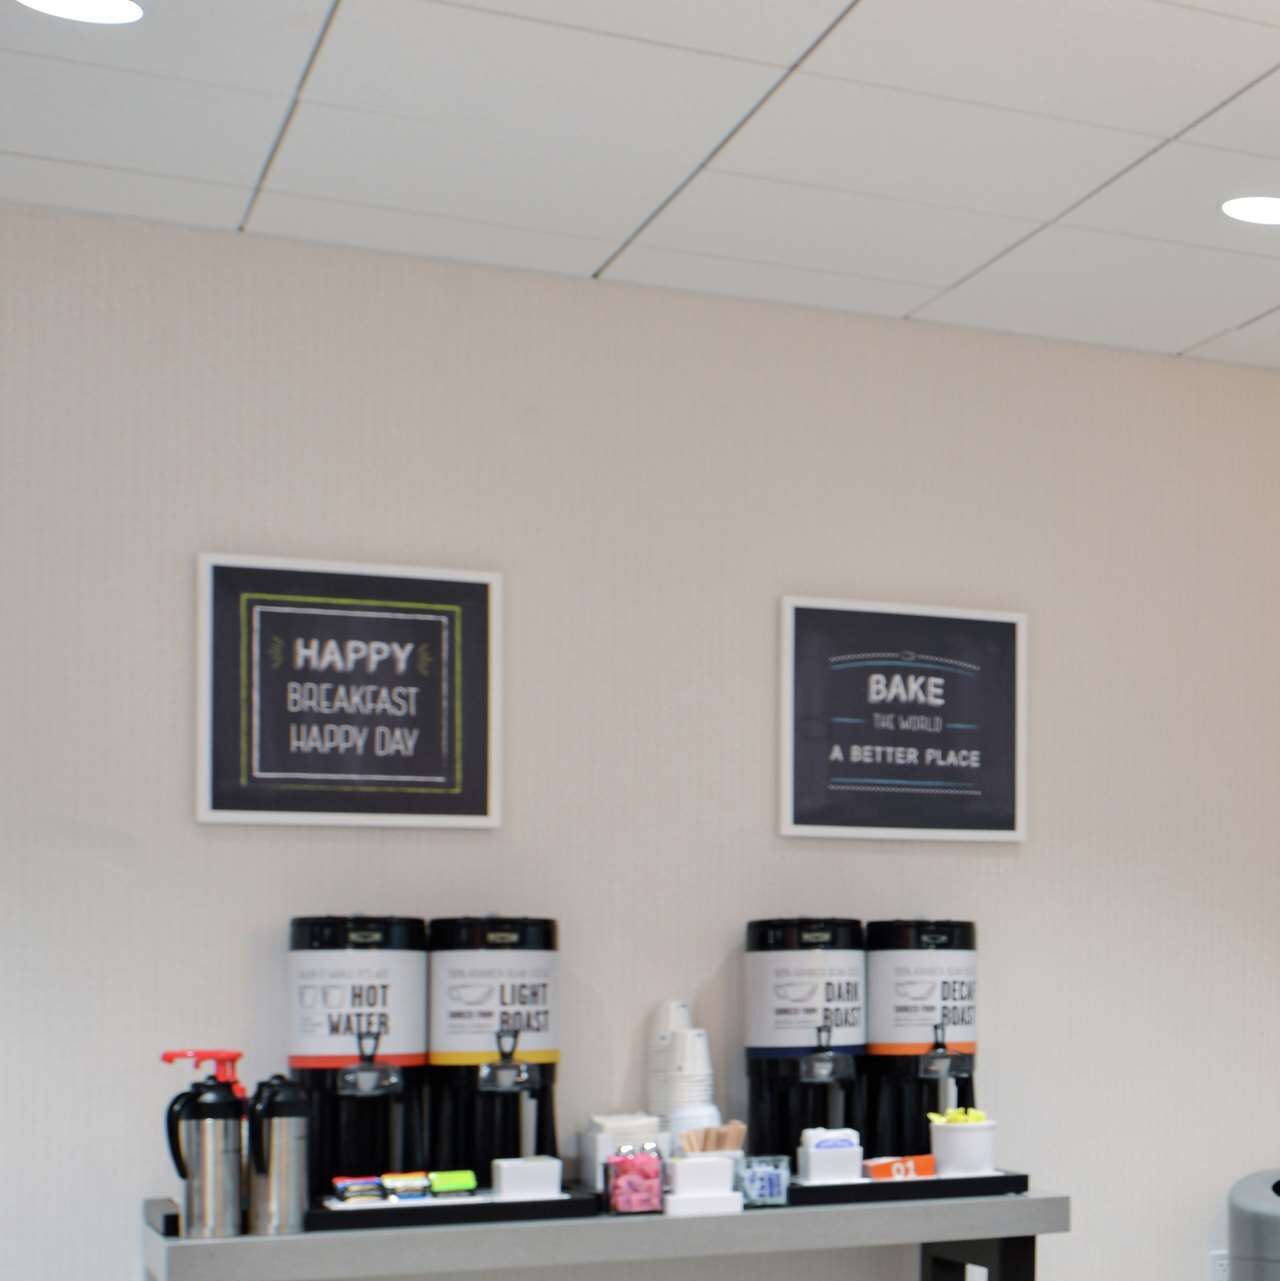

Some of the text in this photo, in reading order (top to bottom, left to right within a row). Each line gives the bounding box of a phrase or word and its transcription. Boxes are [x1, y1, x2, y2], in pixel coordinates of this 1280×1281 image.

[293, 637, 415, 676] HAPPY
[286, 681, 421, 717] BREAKFAST
[867, 673, 947, 707] BAKE
[872, 712, 943, 733] THE WORLD
[289, 723, 421, 757] HAPPY DAY
[829, 744, 982, 768] A BETTER PLACE
[351, 984, 389, 1007] HOT
[500, 982, 548, 1006] LIGHT
[327, 1012, 390, 1035] WATER
